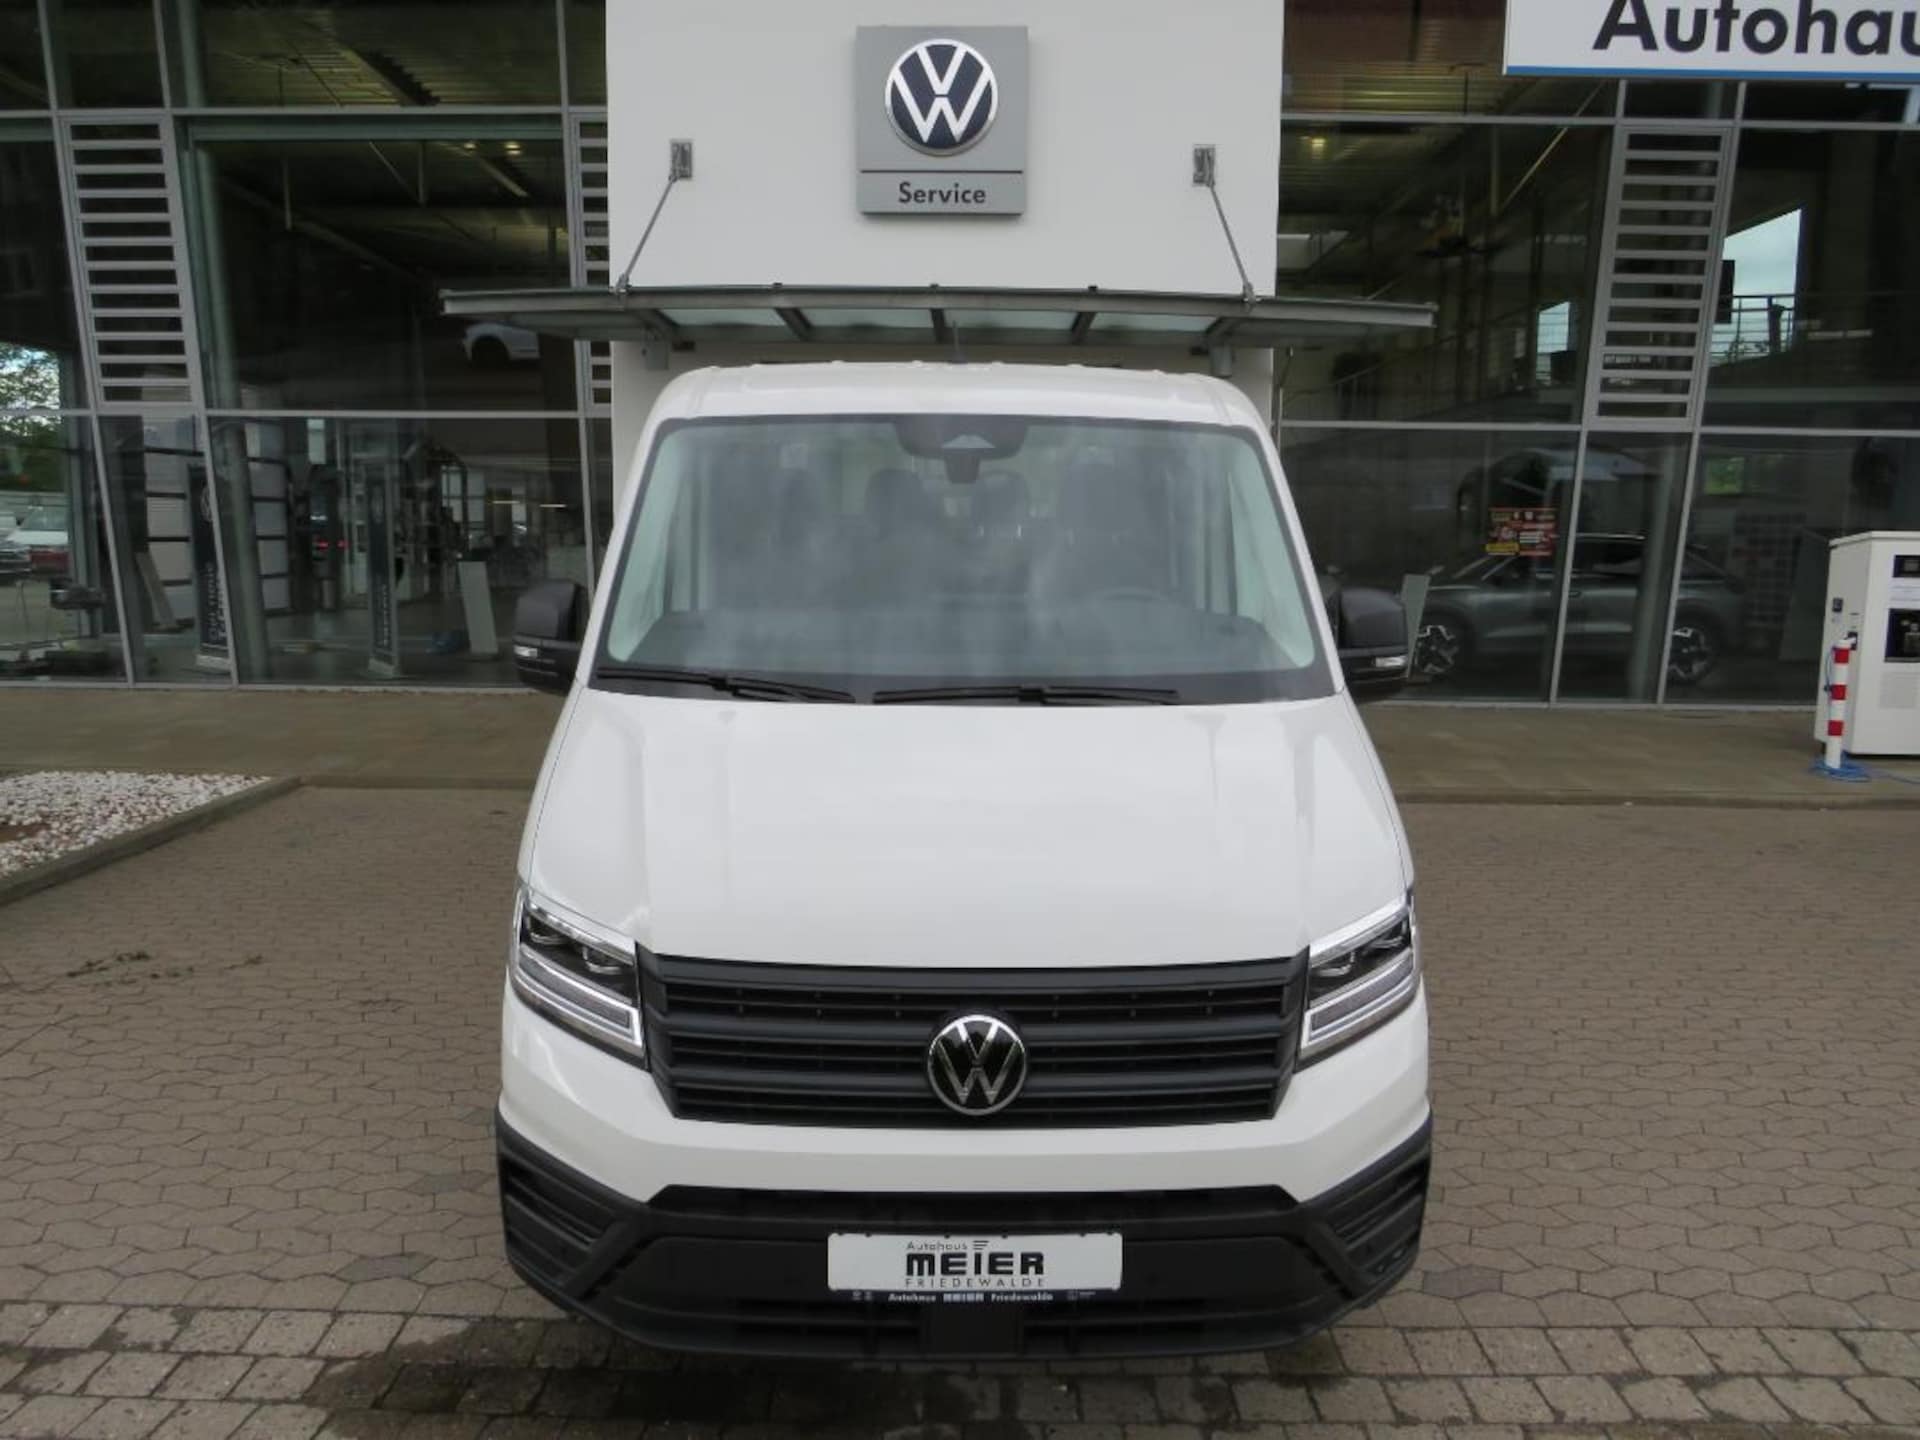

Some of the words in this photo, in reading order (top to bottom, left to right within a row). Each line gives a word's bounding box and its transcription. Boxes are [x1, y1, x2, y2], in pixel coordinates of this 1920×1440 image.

[888, 41, 996, 150] VW
[898, 181, 987, 204] Service
[906, 1240, 967, 1251] Autohaus
[906, 1252, 1044, 1276] MEIER
[905, 1278, 1044, 1288] FRIEDEWALDE
